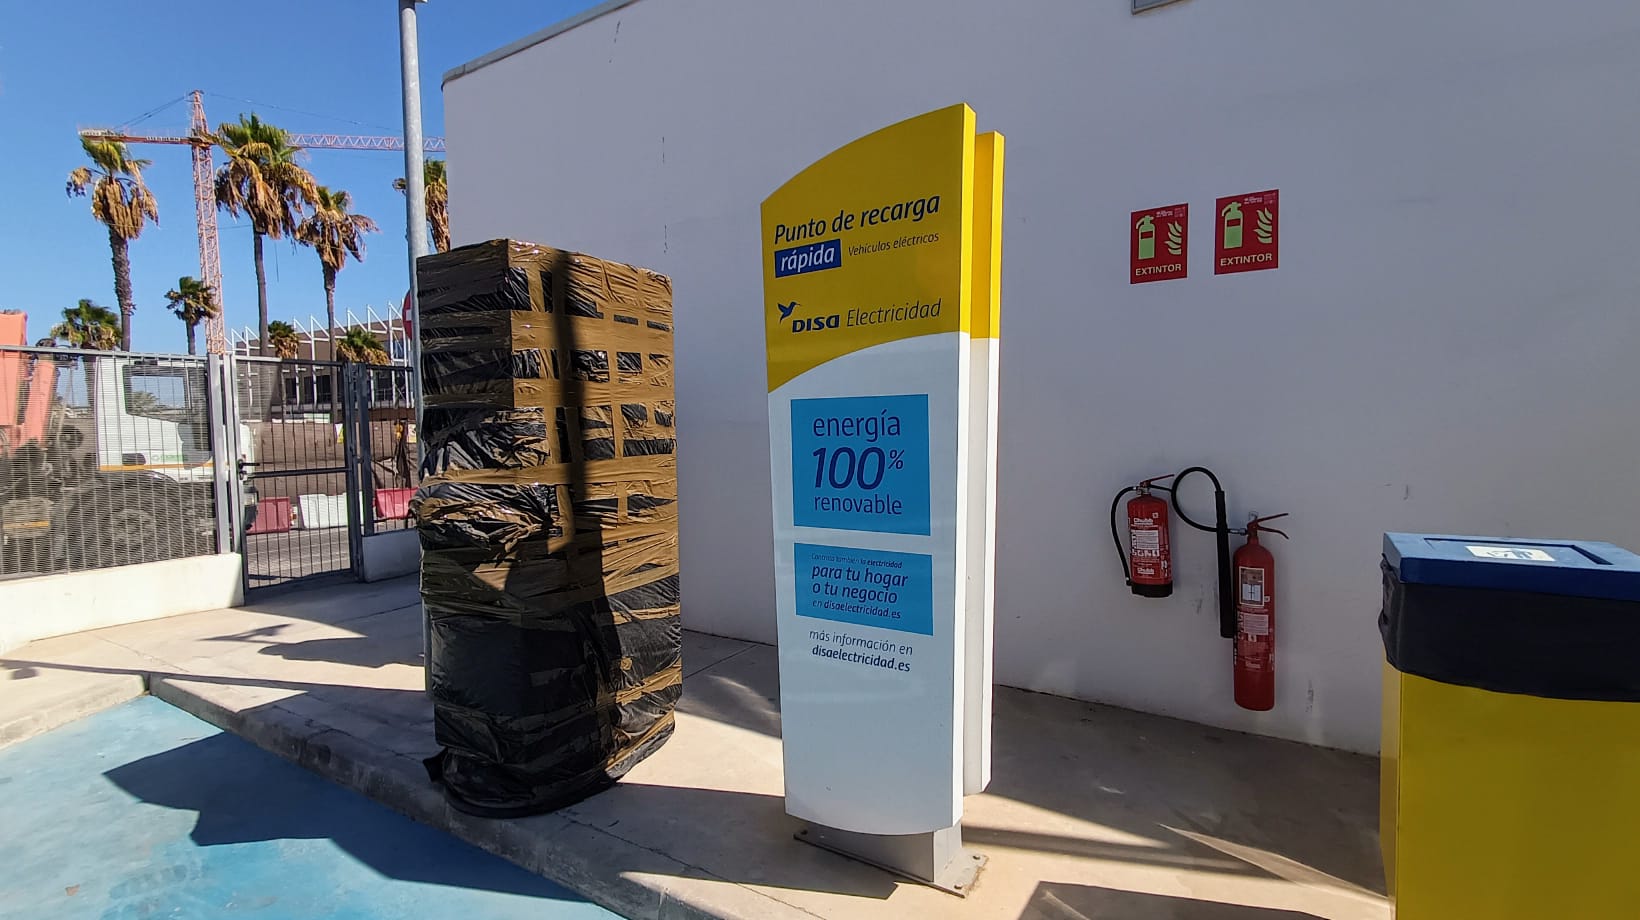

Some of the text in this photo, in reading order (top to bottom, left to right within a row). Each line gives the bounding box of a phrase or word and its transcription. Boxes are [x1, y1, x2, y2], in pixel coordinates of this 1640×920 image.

[774, 195, 941, 245] Punto de recarga
[848, 232, 939, 257] Vehículos eléctricos
[780, 246, 835, 273] rápida
[1135, 263, 1182, 276] EXTINTOR
[1220, 252, 1273, 267] EXTINTOR
[847, 298, 942, 327] Electricidad
[813, 408, 901, 443] energía
[812, 446, 905, 490] 100%
[814, 493, 903, 515] renovable
[866, 558, 903, 569] electricidad
[811, 565, 908, 589] para tu hogar
[812, 581, 898, 604] o tu negocio
[812, 599, 901, 620] en disaelectricidad.es
[809, 629, 913, 657] más información en
[812, 644, 911, 673] disaelectricidad.es
